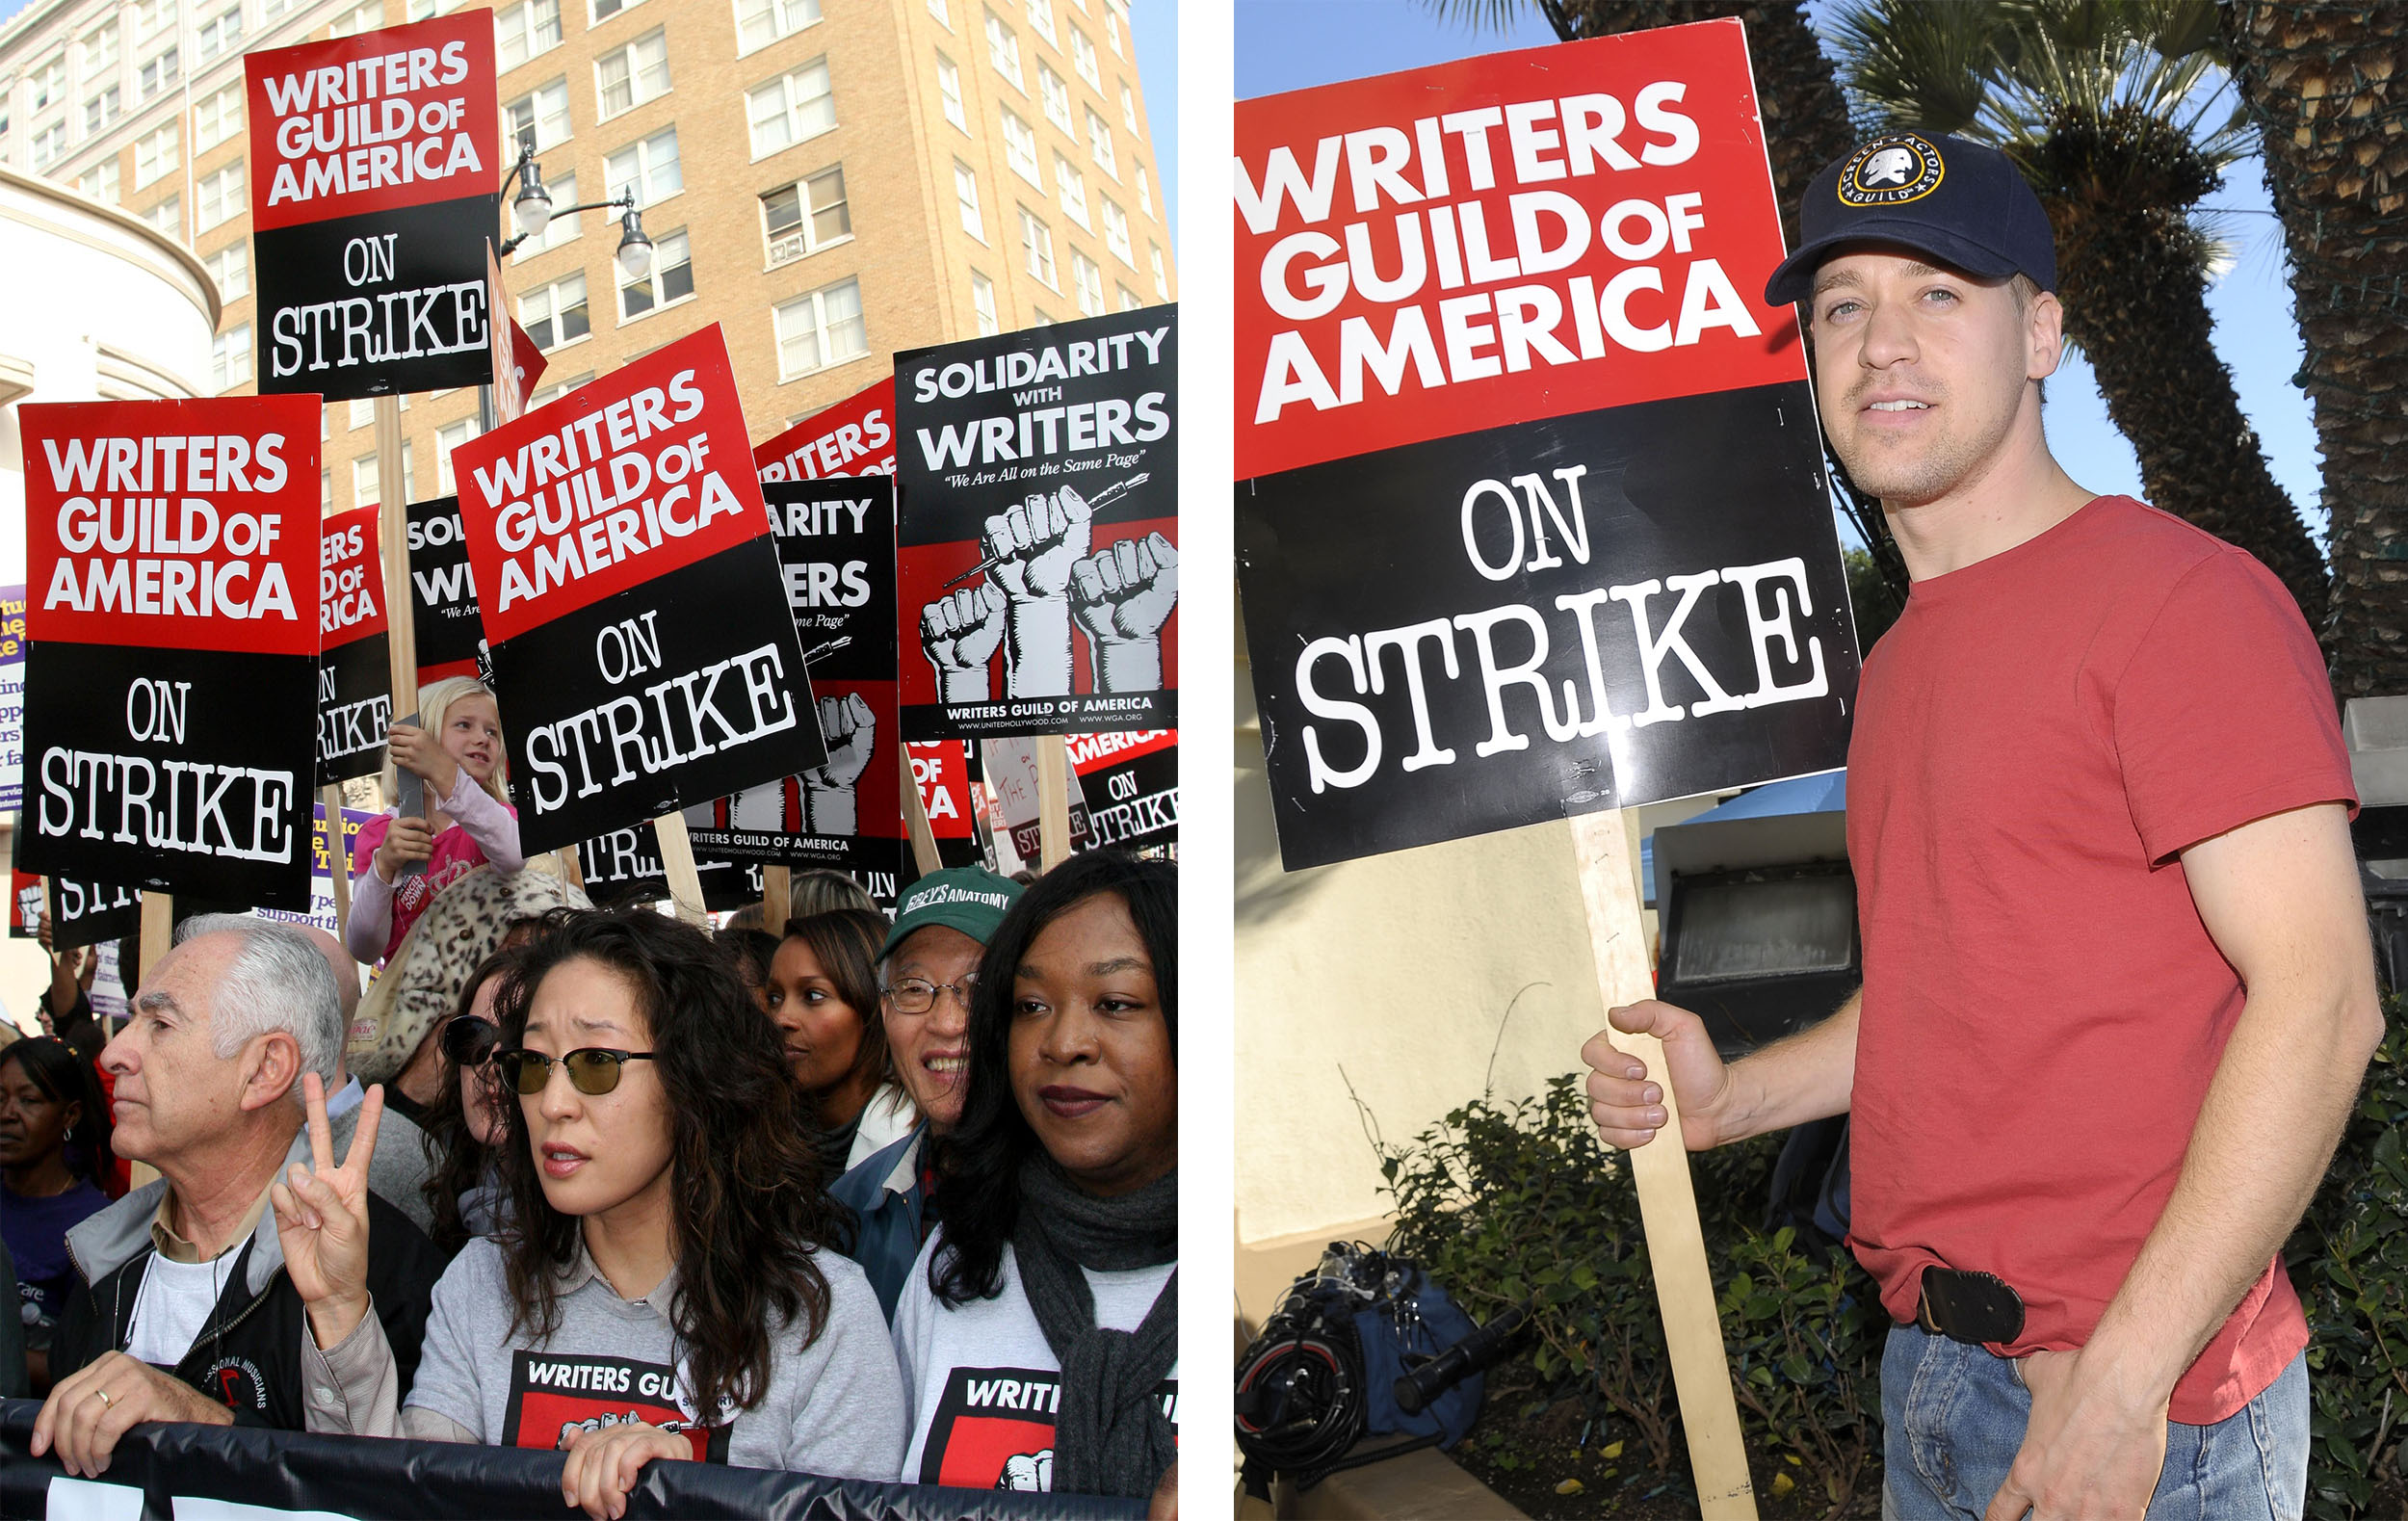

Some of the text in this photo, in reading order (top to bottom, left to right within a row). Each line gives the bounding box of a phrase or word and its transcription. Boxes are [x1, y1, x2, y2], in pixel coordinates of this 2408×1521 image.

[263, 40, 468, 117] WRITERS
[276, 98, 465, 159] GUILD OF
[1235, 80, 1701, 236] WRITERS
[267, 132, 483, 206] AMERICA
[1842, 135, 1939, 192] SCREEN ACTORS
[1853, 189, 1909, 203] GUILD
[344, 233, 398, 286] ON
[1259, 190, 1705, 321] GUILD OF
[273, 279, 488, 378] STRIKE
[1254, 257, 1762, 426] AMERICA
[914, 326, 1170, 404] SOLIDARITY
[1012, 386, 1062, 407] WITH
[473, 369, 705, 509] WRITERS
[757, 408, 891, 482] RITERS
[916, 391, 1170, 471] WRITERS
[42, 433, 288, 494] WRITERS
[495, 432, 711, 554] GUILD OF
[971, 471, 995, 485] Are
[998, 466, 1017, 482] All
[1020, 467, 1036, 479] on
[1039, 461, 1060, 476] the
[1062, 457, 1102, 473] Same
[57, 496, 280, 556] GUILD OF
[498, 470, 744, 614] AMERICA
[1460, 463, 1591, 580] ON
[42, 557, 298, 621] AMERICA
[338, 564, 364, 593] OF
[596, 610, 662, 685] ON
[1295, 556, 1829, 795] STRIKE
[126, 677, 192, 746] ON
[526, 643, 798, 816] STRIKE
[947, 696, 1153, 721] WRITERS GUILD OF AMERICA
[957, 714, 1142, 730] WWW.UNITEDHOLLYWOOD.COM WWW.WGA.ORG
[39, 747, 293, 865] STRIKE
[1000, 776, 1026, 807] THE
[1108, 771, 1139, 801] ON
[733, 834, 770, 847] GUILD
[772, 836, 790, 848] OF
[794, 837, 849, 852] AMERICA
[790, 852, 841, 860] WWW.WGA.ORG
[401, 875, 422, 905] PENCILS
[406, 880, 426, 911] DOWN
[948, 888, 1009, 910] ANATOMY
[241, 1359, 267, 1409] MUSICIANS
[529, 1360, 632, 1393] WRITERS
